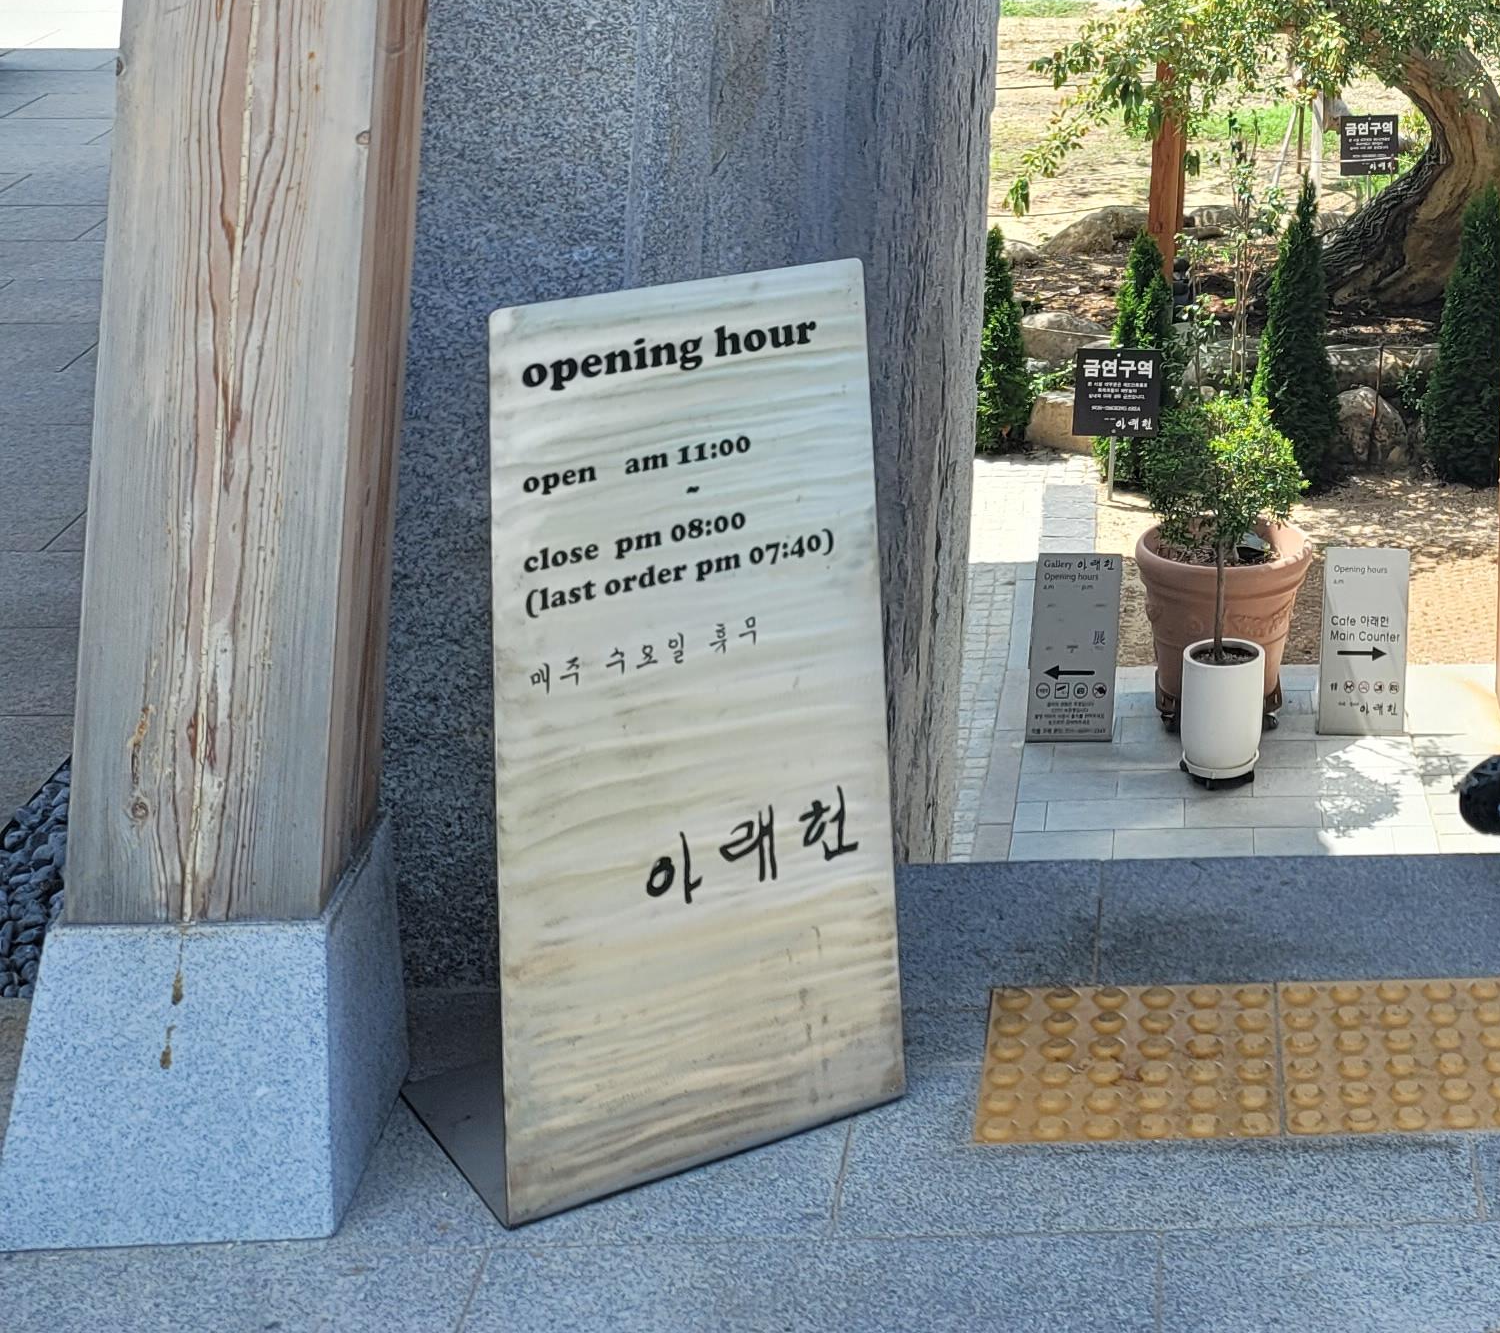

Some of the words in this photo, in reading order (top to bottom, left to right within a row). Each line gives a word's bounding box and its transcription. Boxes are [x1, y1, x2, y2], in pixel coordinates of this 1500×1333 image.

[1344, 120, 1394, 136] 금연구역
[521, 334, 703, 392] opening
[714, 320, 817, 357] hour
[1082, 358, 1153, 379] 금연구역
[522, 464, 598, 496] open
[624, 452, 669, 475] am
[677, 435, 752, 465] 11:00
[523, 543, 600, 573] close
[615, 530, 663, 560] pm
[670, 511, 747, 543] 08:00
[525, 579, 597, 618] (last
[604, 563, 688, 597] order
[695, 551, 742, 582] pm
[748, 528, 835, 566] 07:40)
[1043, 559, 1073, 571] Gallery
[1333, 564, 1366, 575] Opening
[1367, 565, 1388, 574] hours
[1044, 572, 1077, 583] Opening
[1077, 572, 1099, 581] hours
[1330, 615, 1357, 627] Cafe
[1329, 629, 1356, 642] Main
[1358, 630, 1401, 643] Counter
[529, 655, 581, 694] 매주
[605, 633, 685, 674] 수요일
[709, 615, 758, 654] 휴무
[645, 784, 859, 905] 아래헌
